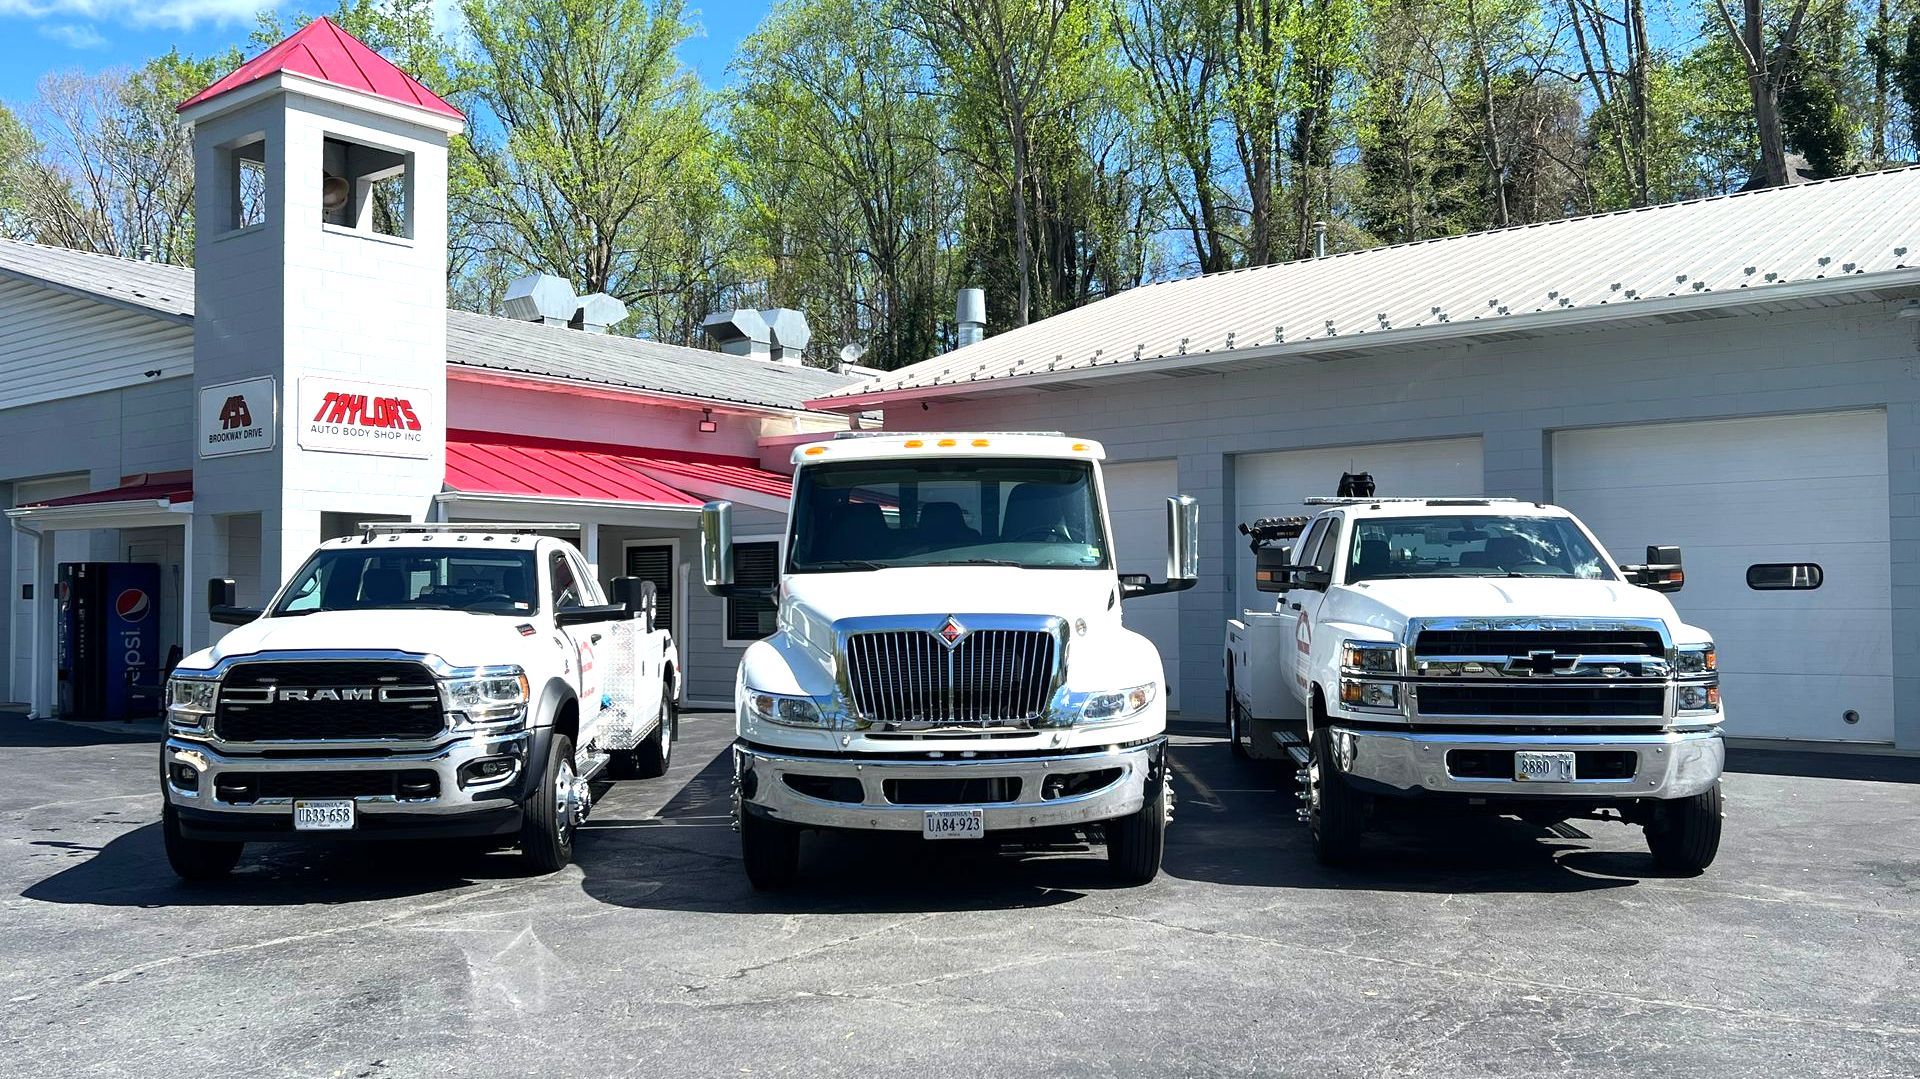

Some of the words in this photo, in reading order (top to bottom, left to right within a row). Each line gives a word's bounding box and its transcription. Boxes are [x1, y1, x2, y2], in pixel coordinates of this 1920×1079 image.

[313, 392, 422, 431] TAYLOR'S
[208, 430, 243, 444] BROOKWAY
[243, 427, 263, 439] DRIVE
[311, 425, 339, 435] AUTO
[343, 427, 371, 438] BODY
[374, 430, 402, 440] SHOP
[279, 688, 373, 701] RAM
[1522, 760, 1550, 774] 8880
[299, 808, 350, 822] UB33-658
[928, 818, 980, 832] UA84-923
